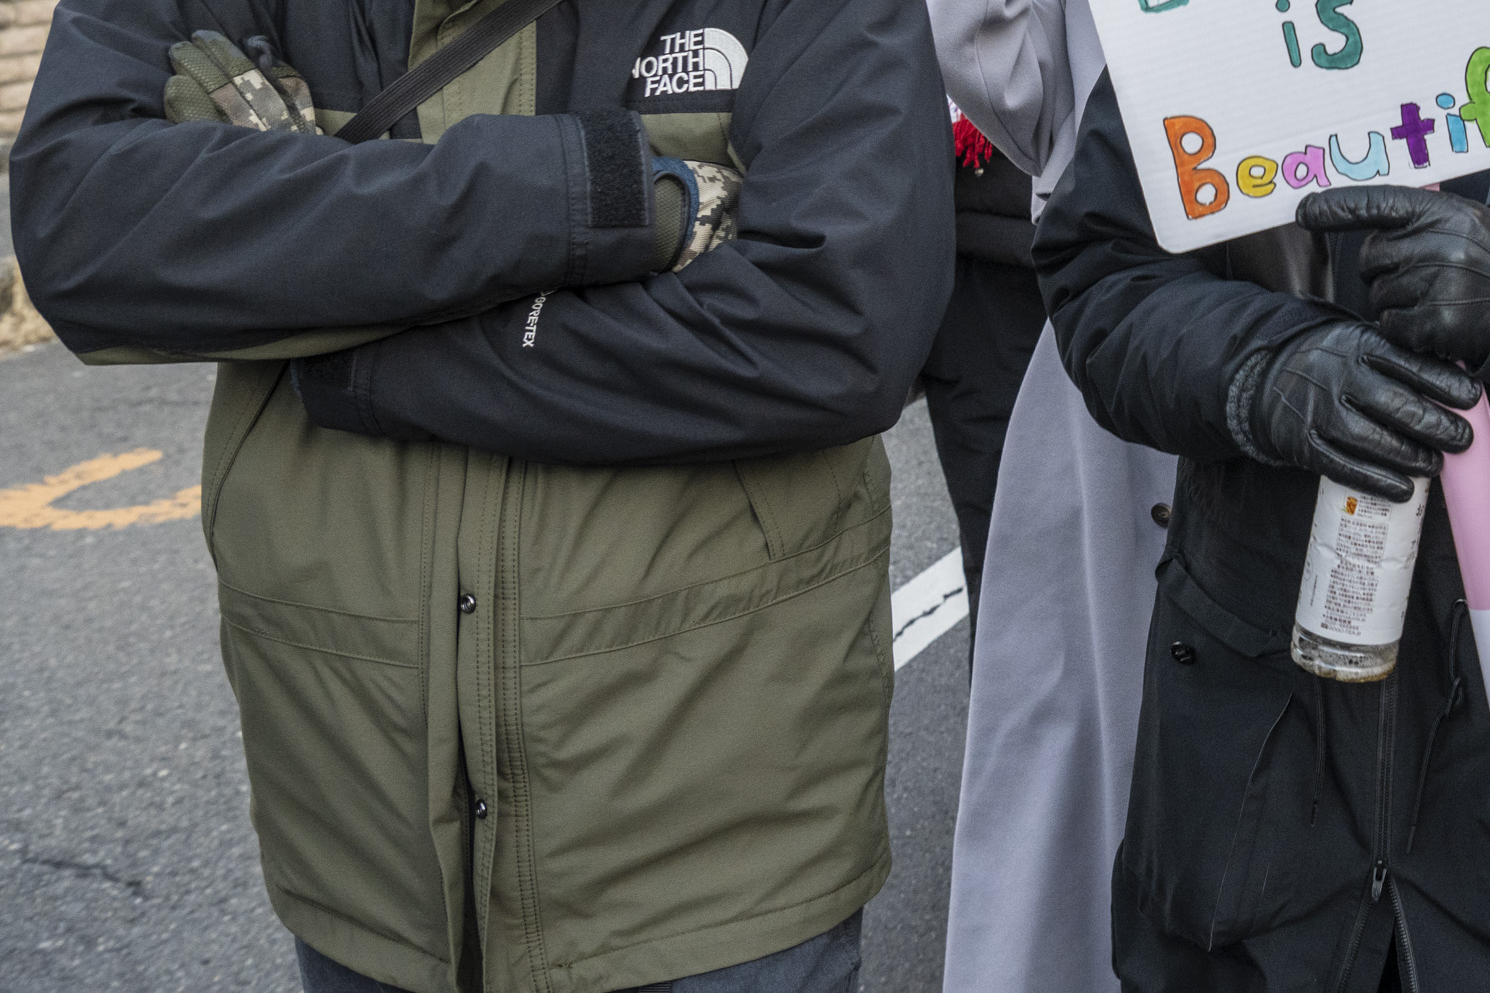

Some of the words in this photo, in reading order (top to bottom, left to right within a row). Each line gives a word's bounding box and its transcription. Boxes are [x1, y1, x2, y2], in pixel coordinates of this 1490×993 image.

[660, 29, 704, 54] THE
[644, 71, 704, 97] FACE
[522, 297, 546, 347] GORE-TEX
